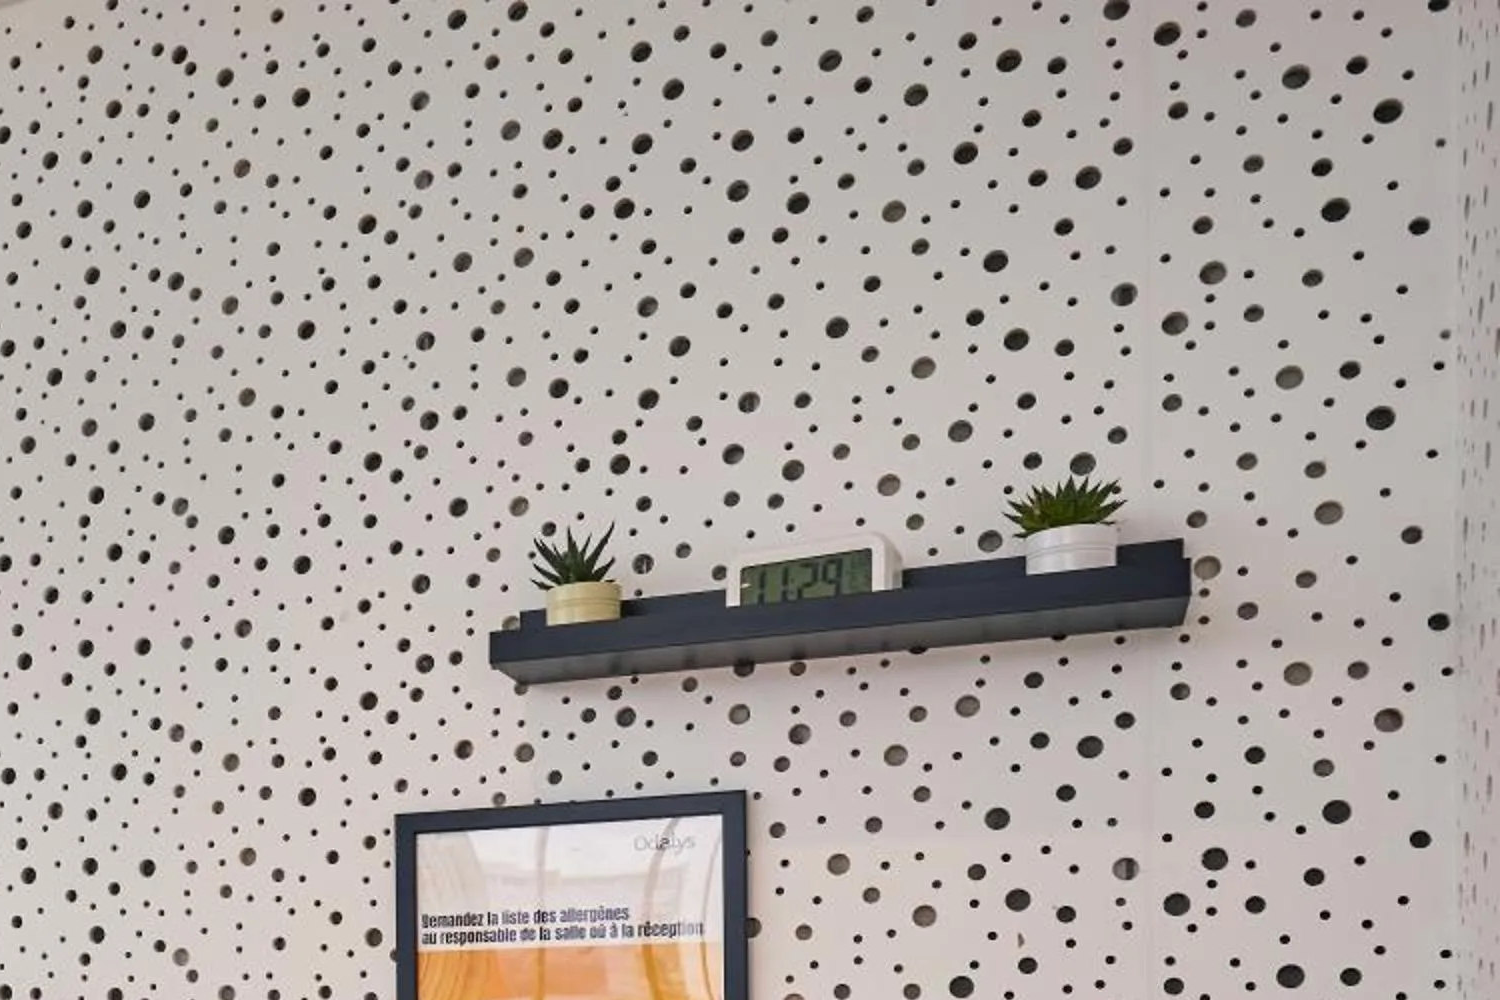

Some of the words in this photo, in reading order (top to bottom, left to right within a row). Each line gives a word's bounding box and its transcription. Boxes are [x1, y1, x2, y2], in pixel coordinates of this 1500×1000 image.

[633, 832, 696, 856] Odalys
[421, 911, 484, 929] Demandez
[486, 910, 499, 926] la
[501, 909, 531, 925] liste
[533, 908, 557, 923] des
[421, 931, 437, 945] au
[440, 926, 518, 946] responsable
[520, 926, 537, 941] de
[539, 925, 552, 941] la
[555, 924, 586, 941] salle
[621, 922, 635, 938] la
[637, 920, 705, 939] réception
